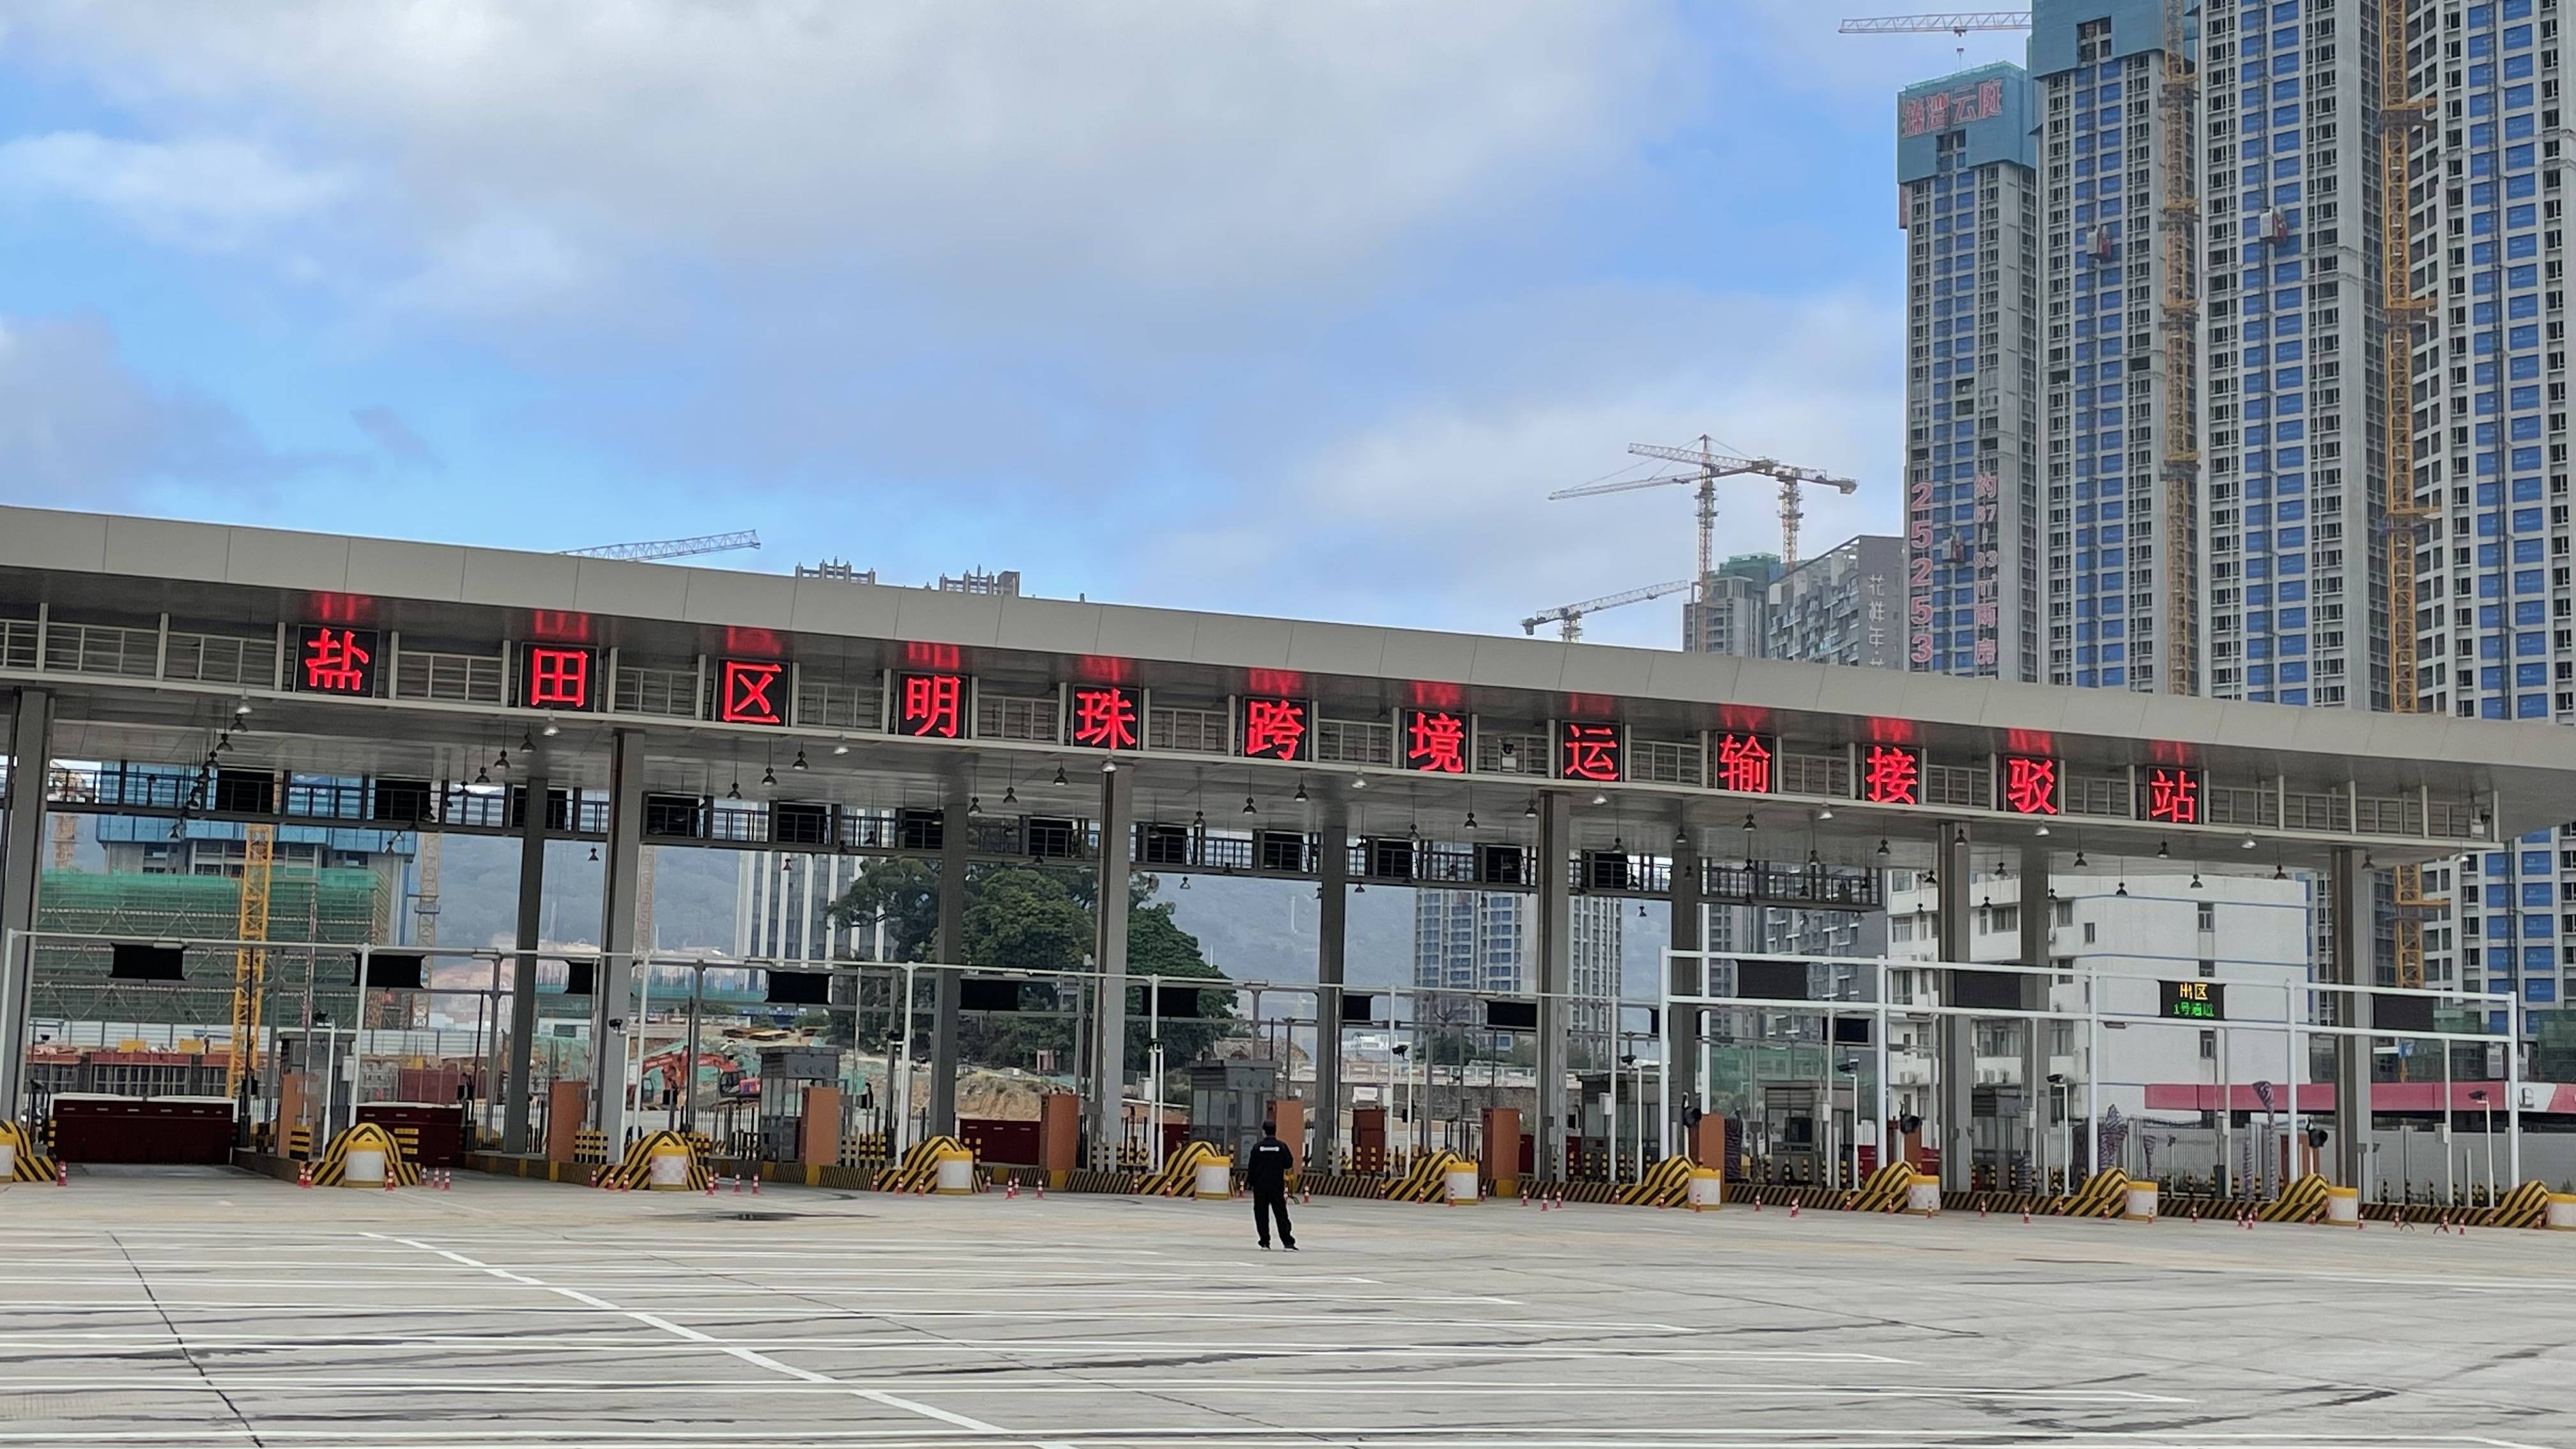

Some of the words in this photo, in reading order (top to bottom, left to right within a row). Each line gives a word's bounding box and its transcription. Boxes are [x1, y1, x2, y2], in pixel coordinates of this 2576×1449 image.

[1910, 482, 1933, 674] 25253
[304, 628, 2198, 824] 盐田区明珠跨境运输接驳站
[2174, 1002, 2214, 1017] 1号通道
[2179, 982, 2209, 1000] 出区
